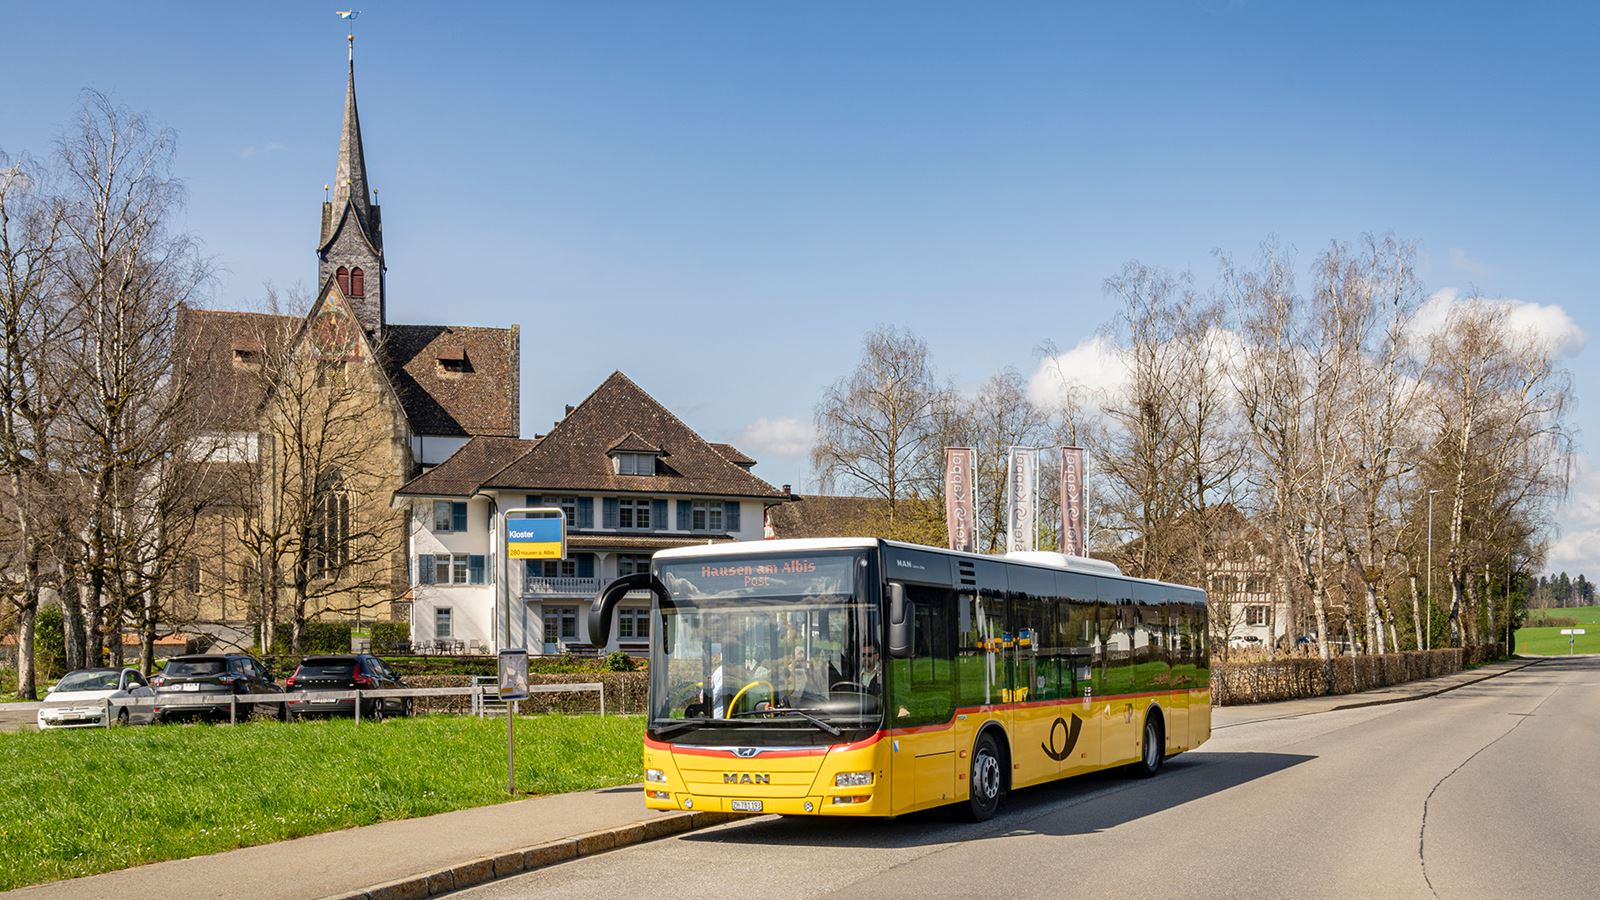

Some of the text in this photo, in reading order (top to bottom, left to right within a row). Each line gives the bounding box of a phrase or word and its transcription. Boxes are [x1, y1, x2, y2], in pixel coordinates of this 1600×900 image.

[509, 530, 534, 539] Kloster
[701, 559, 817, 577] Hausen am Albis
[896, 559, 912, 568] MAN
[744, 575, 770, 587] Post
[723, 773, 770, 785] MAN
